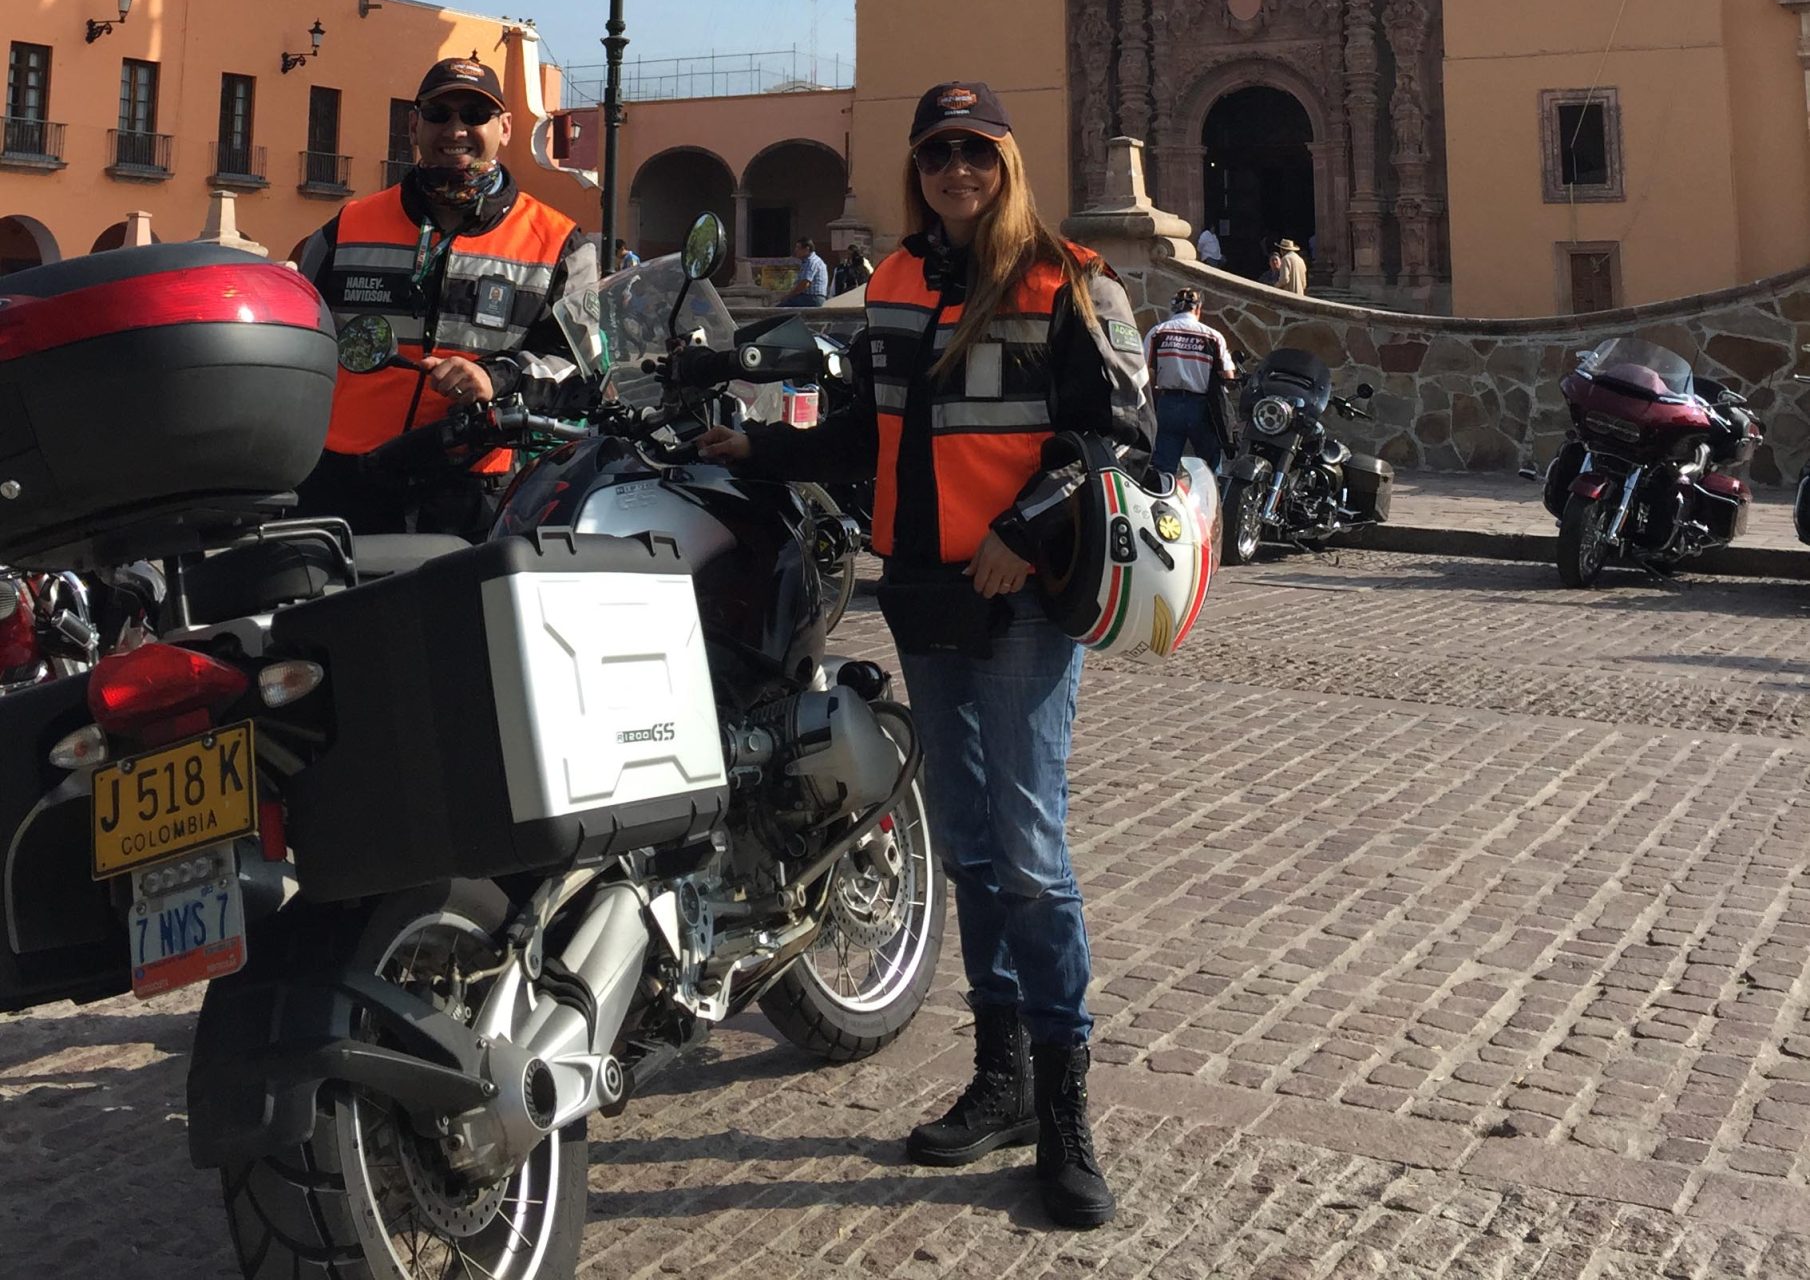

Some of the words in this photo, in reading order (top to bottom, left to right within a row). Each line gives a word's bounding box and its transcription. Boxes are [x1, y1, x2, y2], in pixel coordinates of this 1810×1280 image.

[346, 276, 384, 289] HARLEY-
[1160, 341, 1204, 351] DAVIDSON
[101, 779, 120, 833] J
[137, 755, 205, 821] 518
[219, 740, 244, 796] K
[121, 809, 218, 856] COLOMBIA
[136, 917, 149, 964] 7
[216, 892, 229, 940] 7
